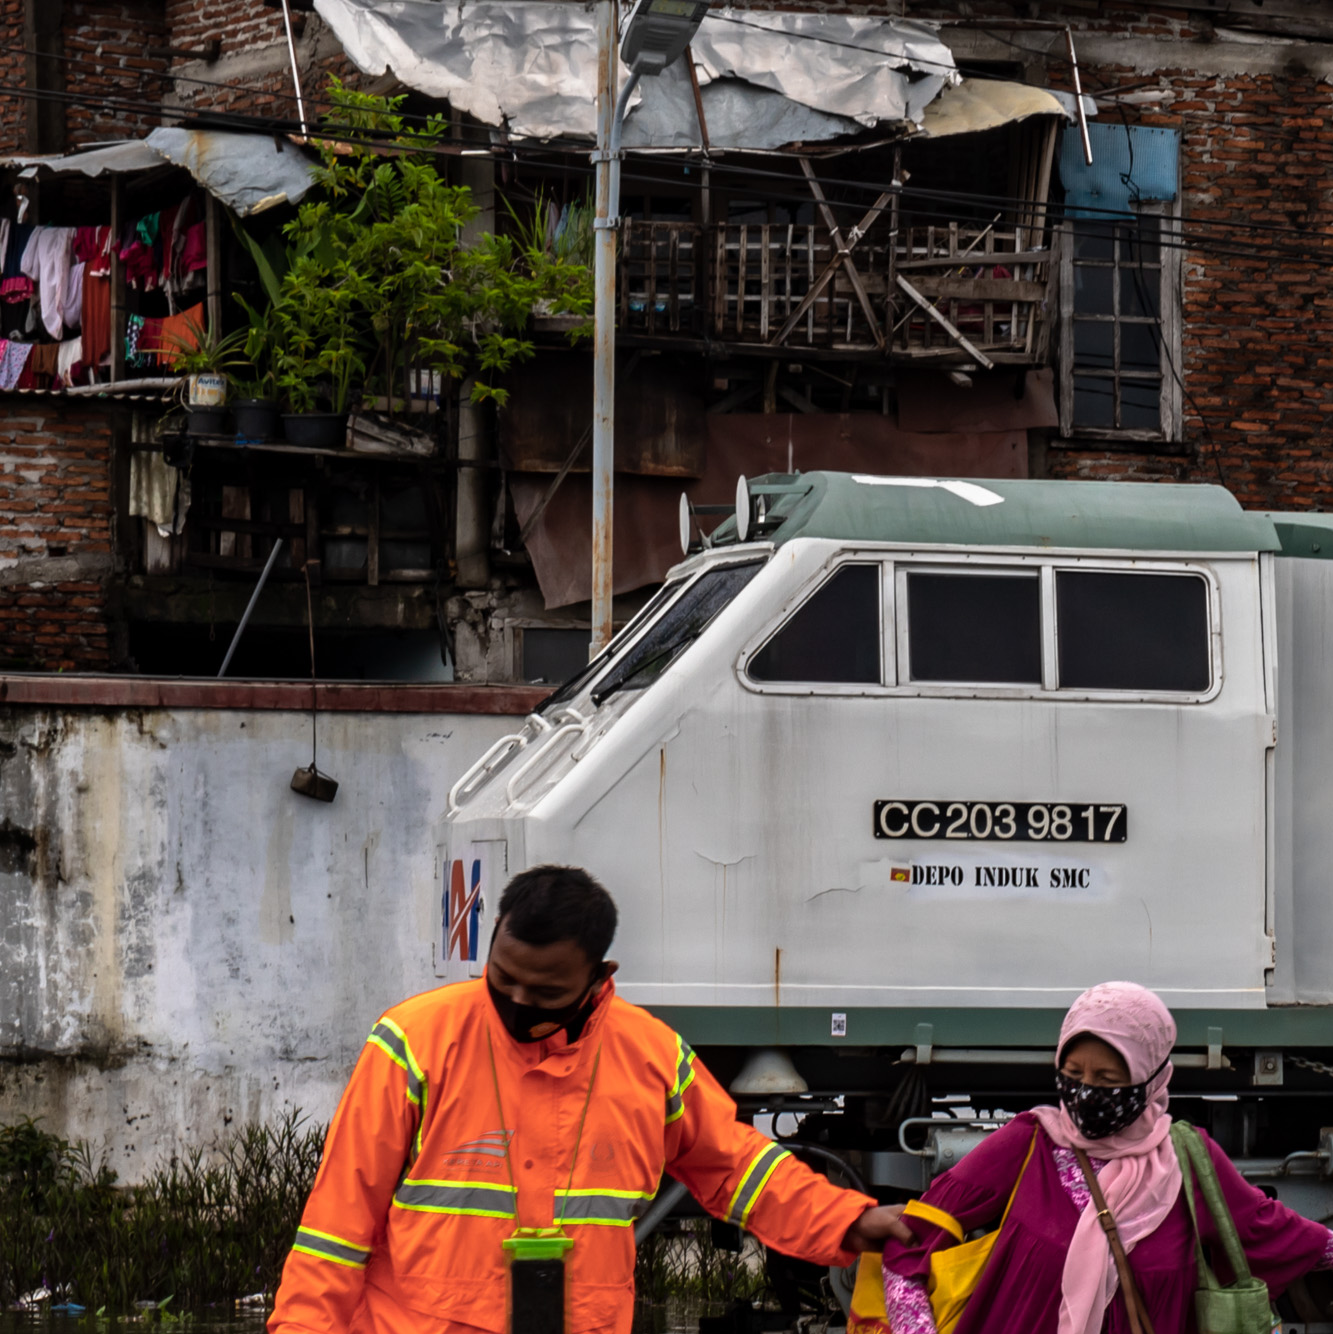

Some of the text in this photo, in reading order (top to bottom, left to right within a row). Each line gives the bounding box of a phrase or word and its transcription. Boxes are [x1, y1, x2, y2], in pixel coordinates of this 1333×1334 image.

[1027, 805, 1074, 841] 98
[1080, 805, 1123, 842] 17
[912, 865, 1090, 889] DEPO INDUK SMC
